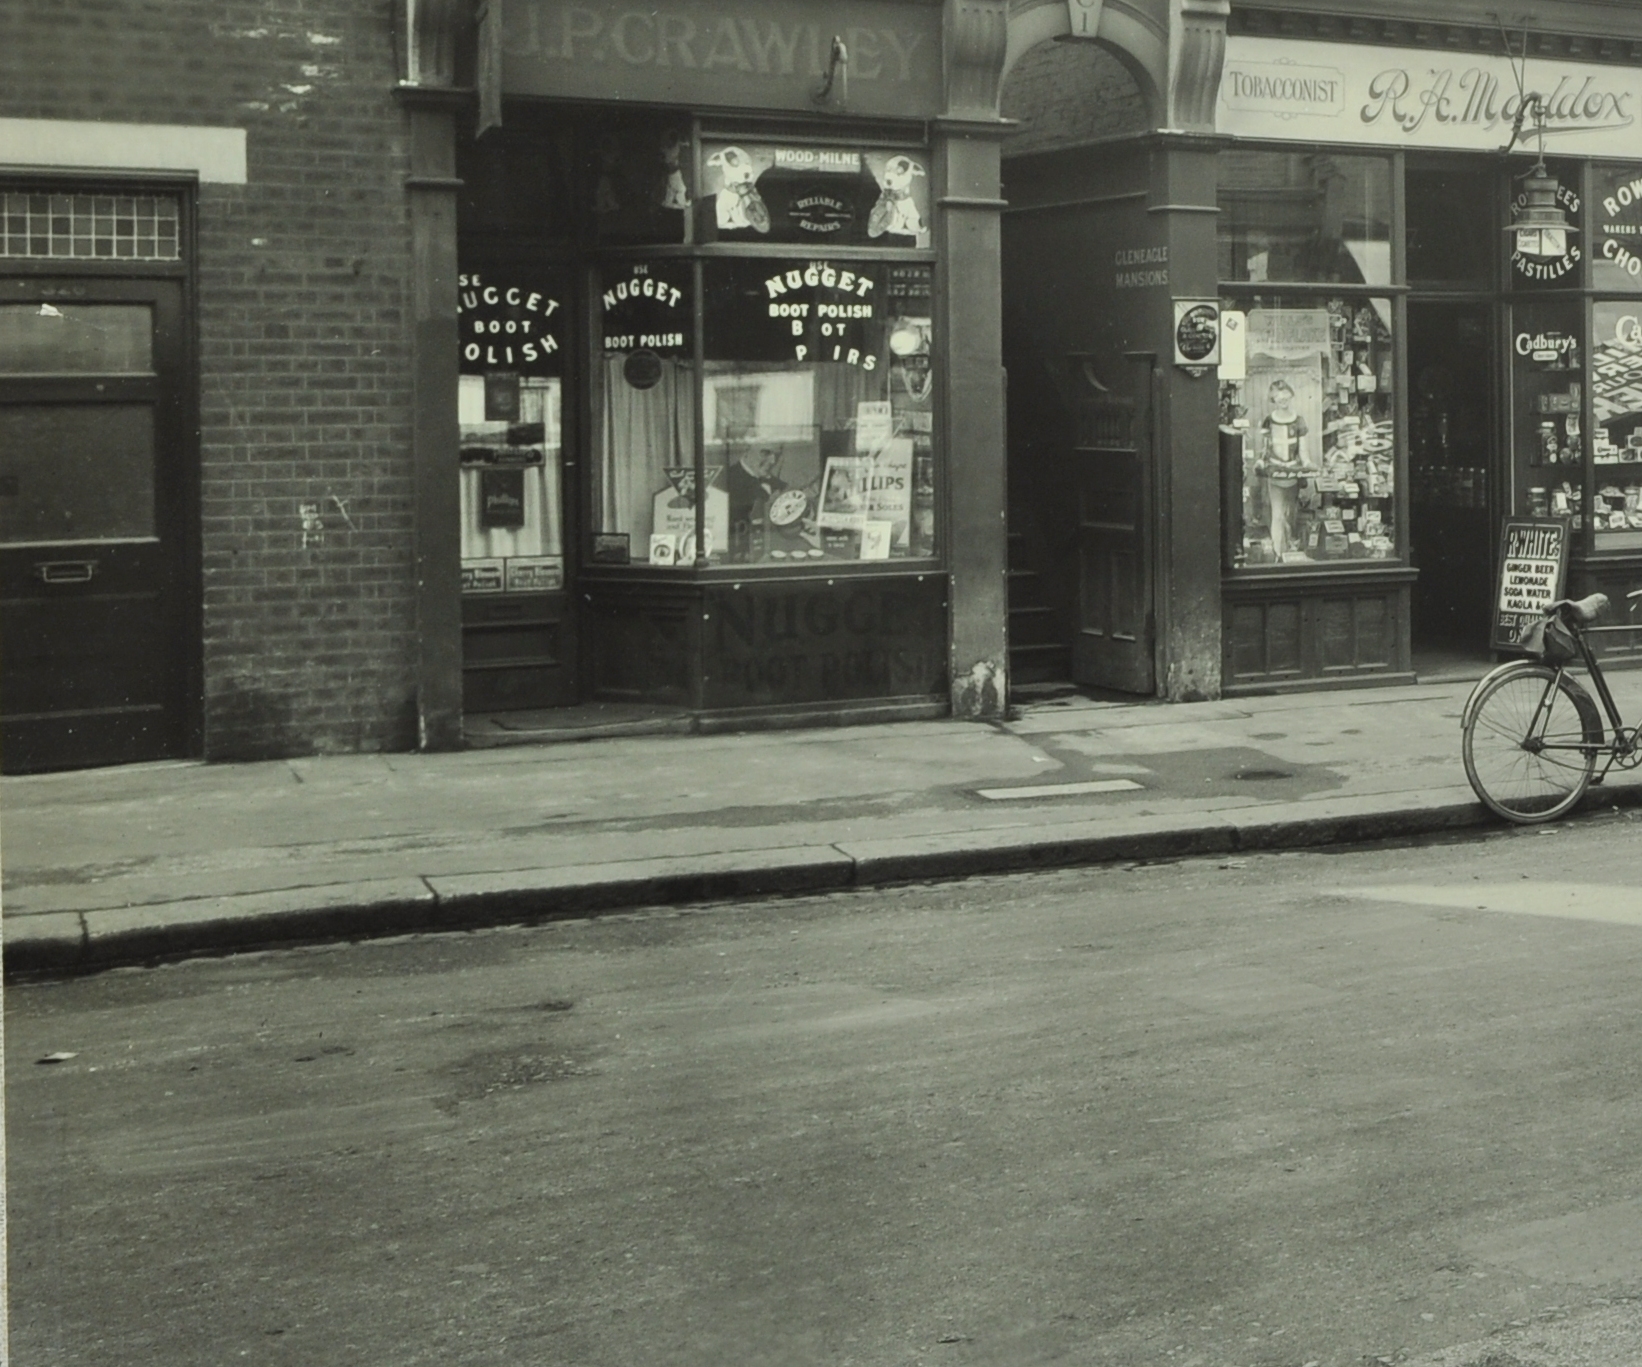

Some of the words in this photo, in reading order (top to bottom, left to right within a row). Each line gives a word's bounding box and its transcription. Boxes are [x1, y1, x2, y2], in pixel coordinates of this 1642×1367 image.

[1229, 71, 1338, 103] TOBACCONIST
[775, 149, 861, 166] WOOD-MILNE
[796, 196, 843, 209] RELIABLE
[799, 219, 841, 232] REPAIRS
[1511, 244, 1581, 280] PASTILLES
[458, 274, 482, 287] SE
[765, 268, 874, 299] NUGGET
[1115, 270, 1169, 289] MANSIONS
[457, 286, 560, 317] UGGET
[602, 279, 682, 311] NUGGET
[769, 303, 809, 318] BOOT
[817, 304, 872, 319] POLISH
[473, 320, 532, 334] BOOT
[464, 334, 559, 364] OLISH
[604, 335, 634, 349] BOOT
[640, 333, 683, 347] POLISH
[1515, 333, 1577, 355] Cadbury's
[1506, 563, 1532, 573] GINGER
[1534, 564, 1554, 575] BEER
[1509, 575, 1549, 587] LEMONADE
[1503, 586, 1524, 598] SODA
[1526, 588, 1551, 599] WATER
[1506, 599, 1533, 610] KAOLA
